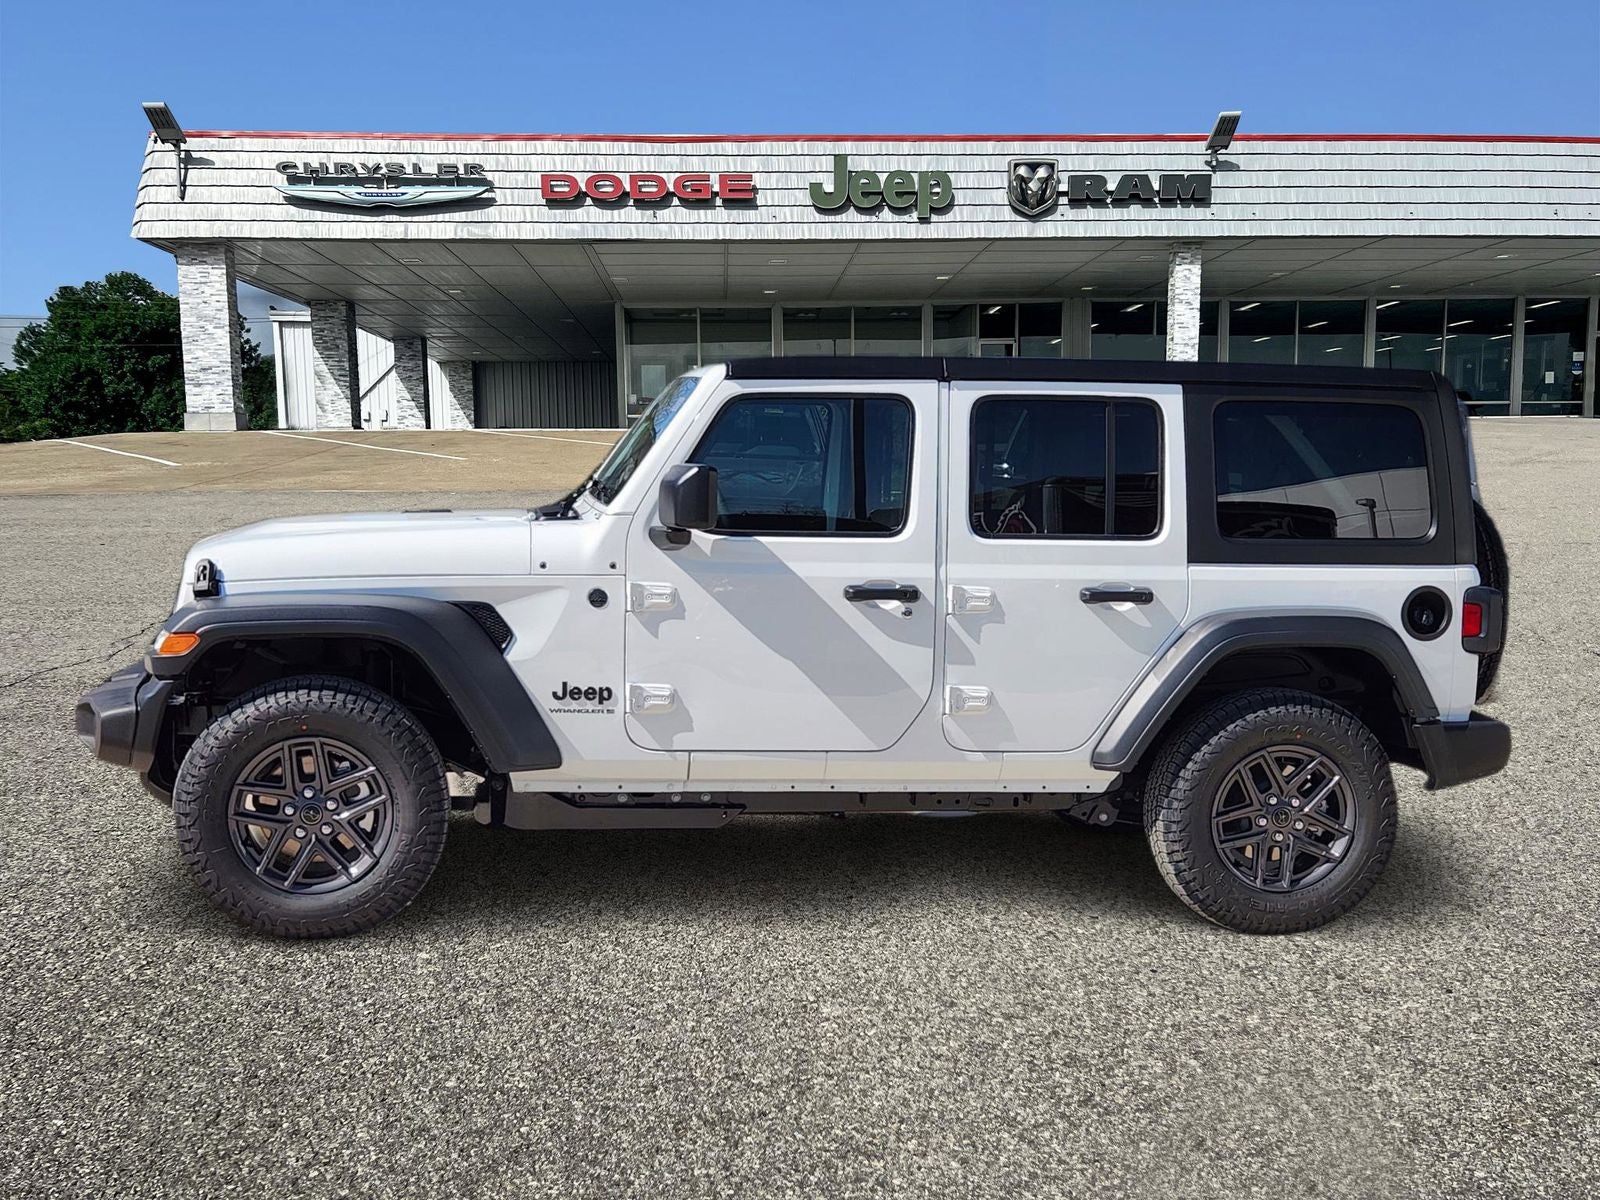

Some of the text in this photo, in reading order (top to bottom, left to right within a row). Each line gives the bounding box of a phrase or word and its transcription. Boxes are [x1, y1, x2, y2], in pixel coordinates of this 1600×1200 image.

[275, 161, 486, 177] CHRYSLER
[540, 173, 756, 201] DODGE
[808, 155, 953, 219] Jeep
[1068, 173, 1213, 201] RAM
[551, 681, 613, 705] Jeep
